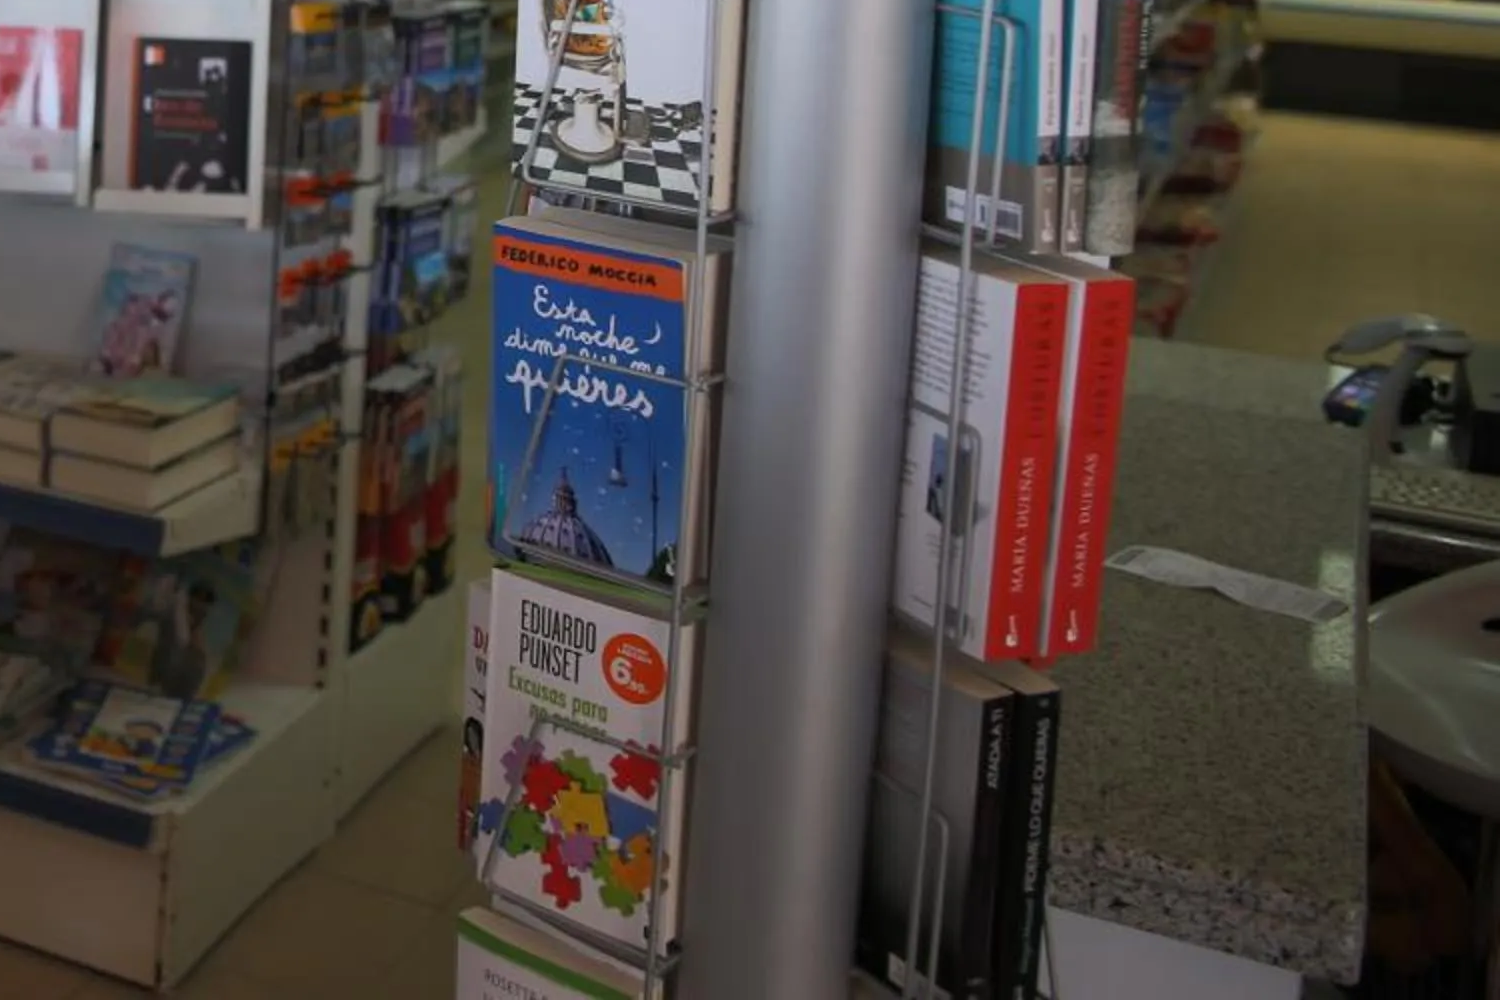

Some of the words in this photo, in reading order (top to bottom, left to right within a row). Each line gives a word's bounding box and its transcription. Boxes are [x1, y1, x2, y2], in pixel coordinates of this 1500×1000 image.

[501, 245, 580, 273] FEDERICO
[588, 264, 658, 287] MOCCIA
[533, 284, 597, 326] Esta
[504, 327, 567, 357] dime
[555, 314, 640, 354] noche
[505, 359, 654, 418] quieres
[521, 599, 597, 655] EDUARDO
[519, 633, 583, 685] PUNSET
[508, 666, 567, 708] Excusas
[572, 696, 609, 724] para
[1027, 817, 1043, 838] LO
